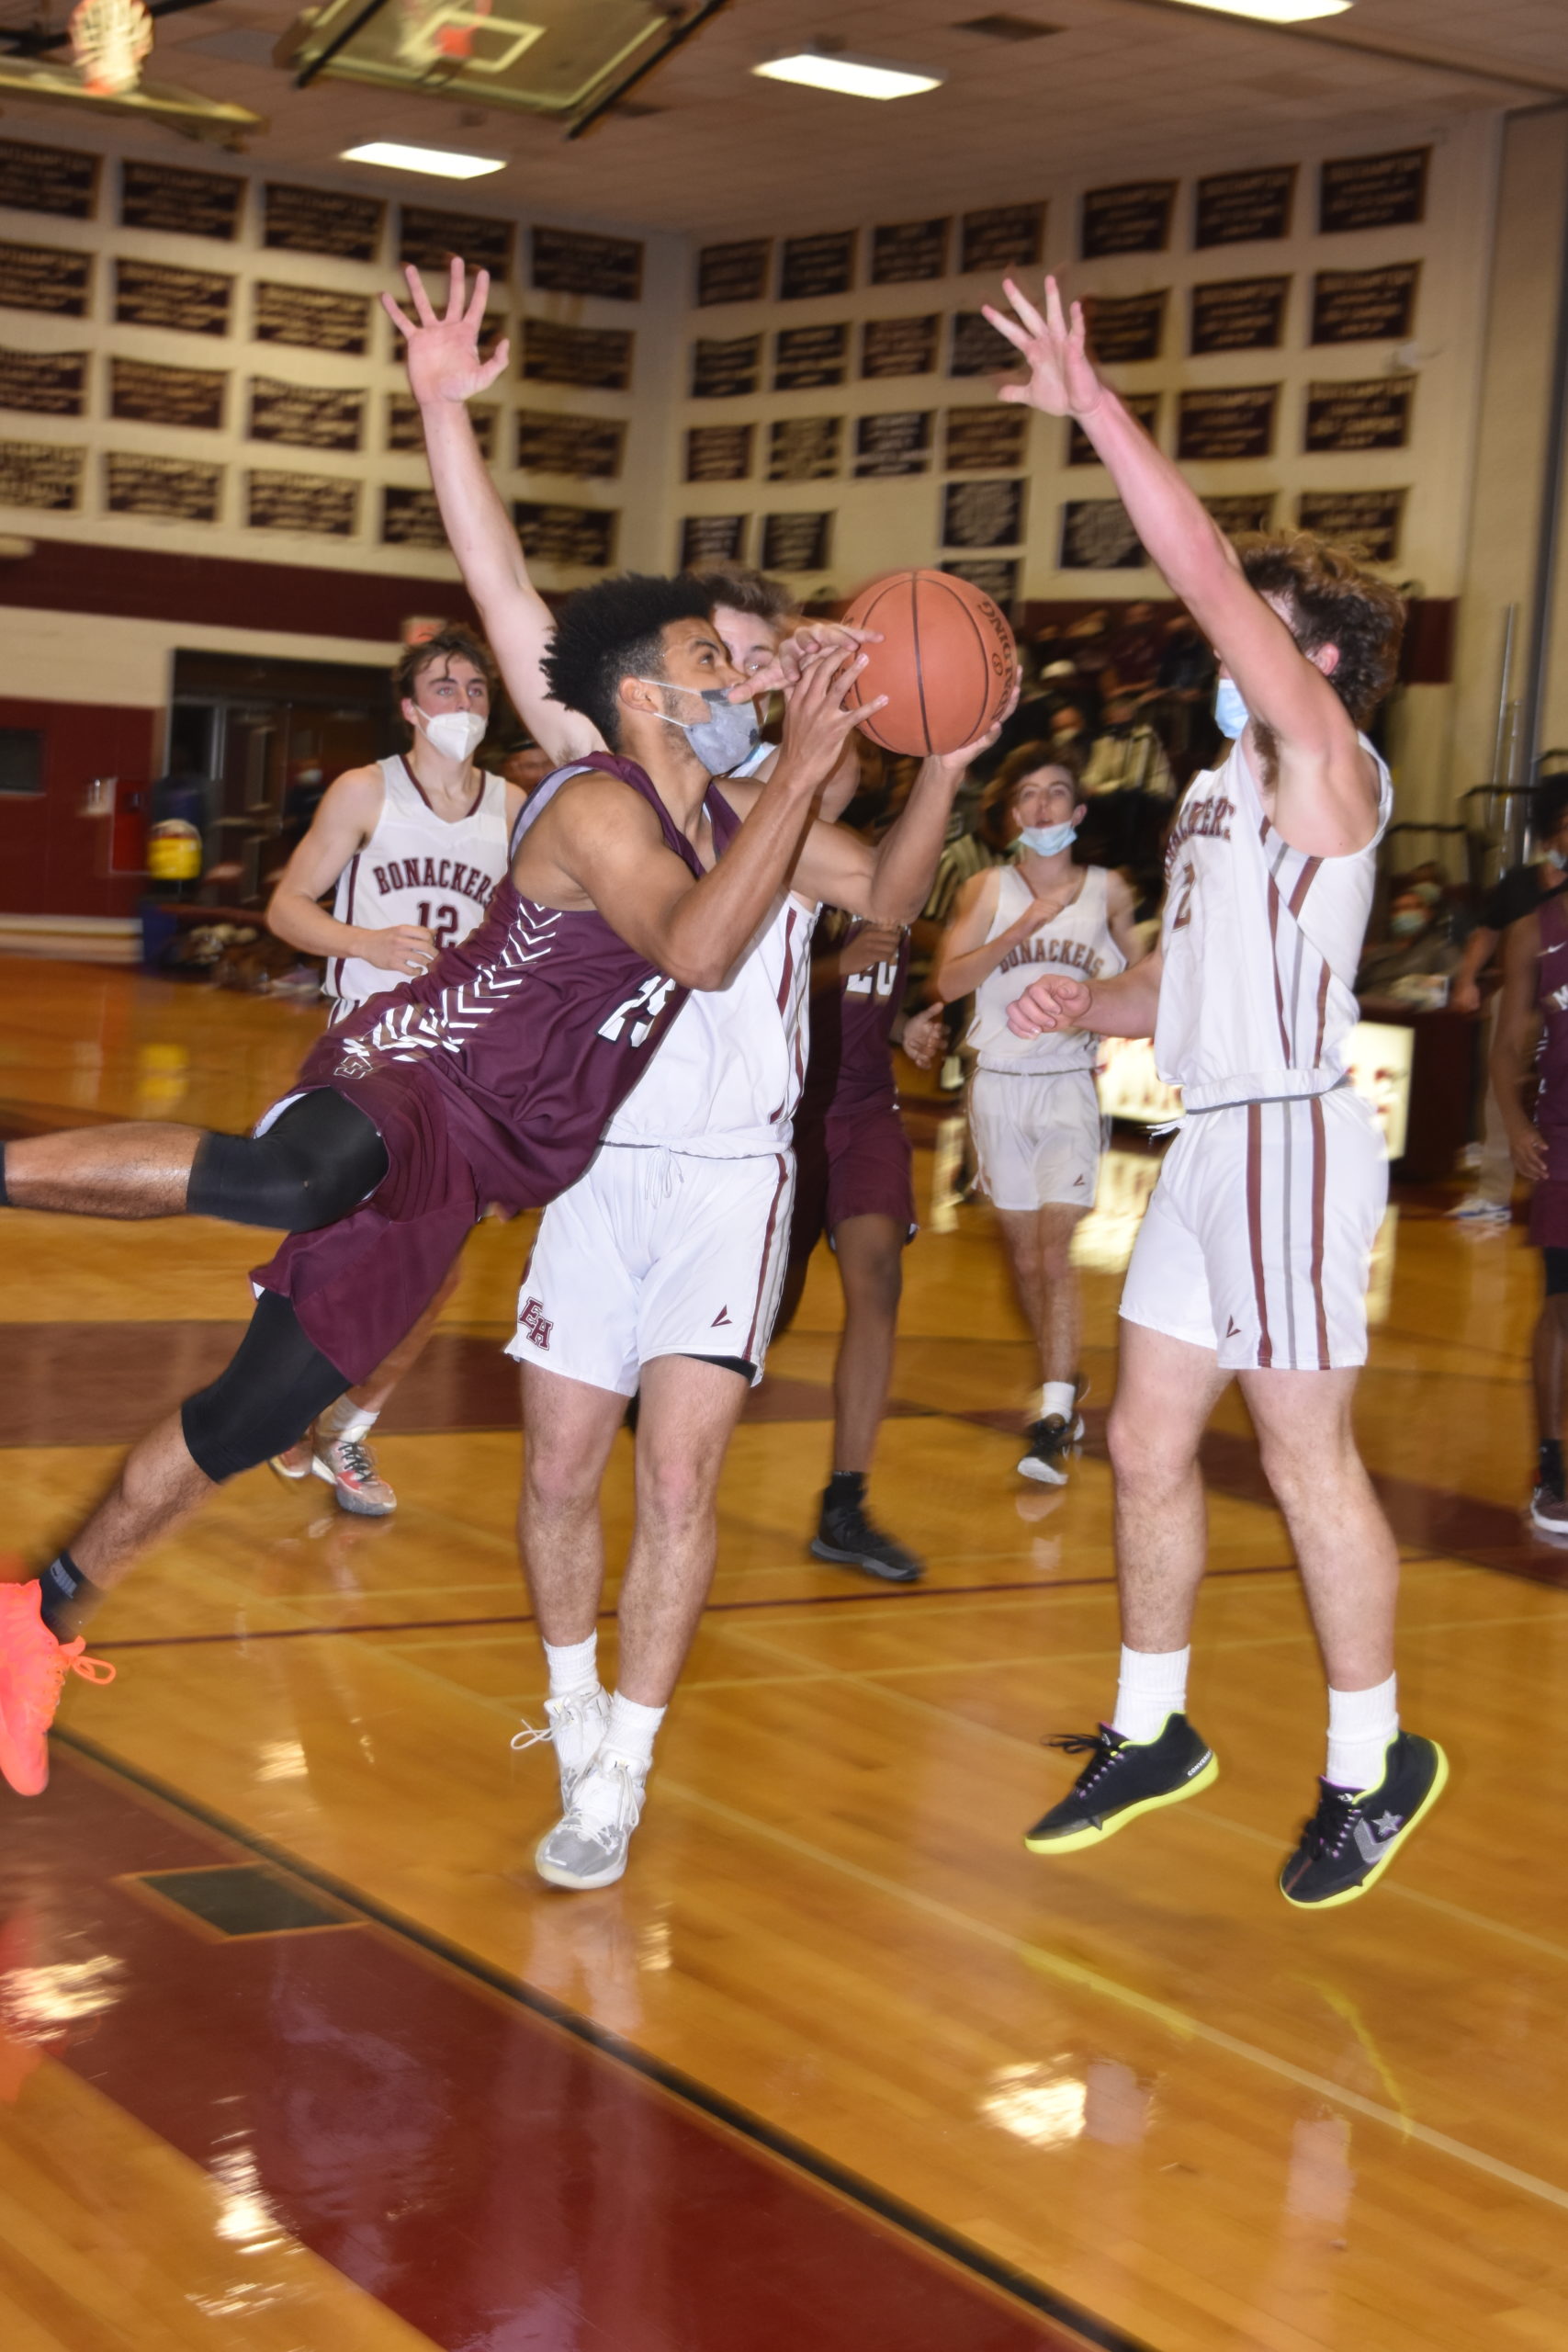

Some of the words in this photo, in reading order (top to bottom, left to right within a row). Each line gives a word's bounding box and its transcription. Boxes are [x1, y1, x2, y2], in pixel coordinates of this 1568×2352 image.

[373, 856, 494, 908] BONACKERS
[418, 901, 458, 949] 12
[999, 937, 1105, 977] BONACKERS
[597, 975, 676, 1048] 25
